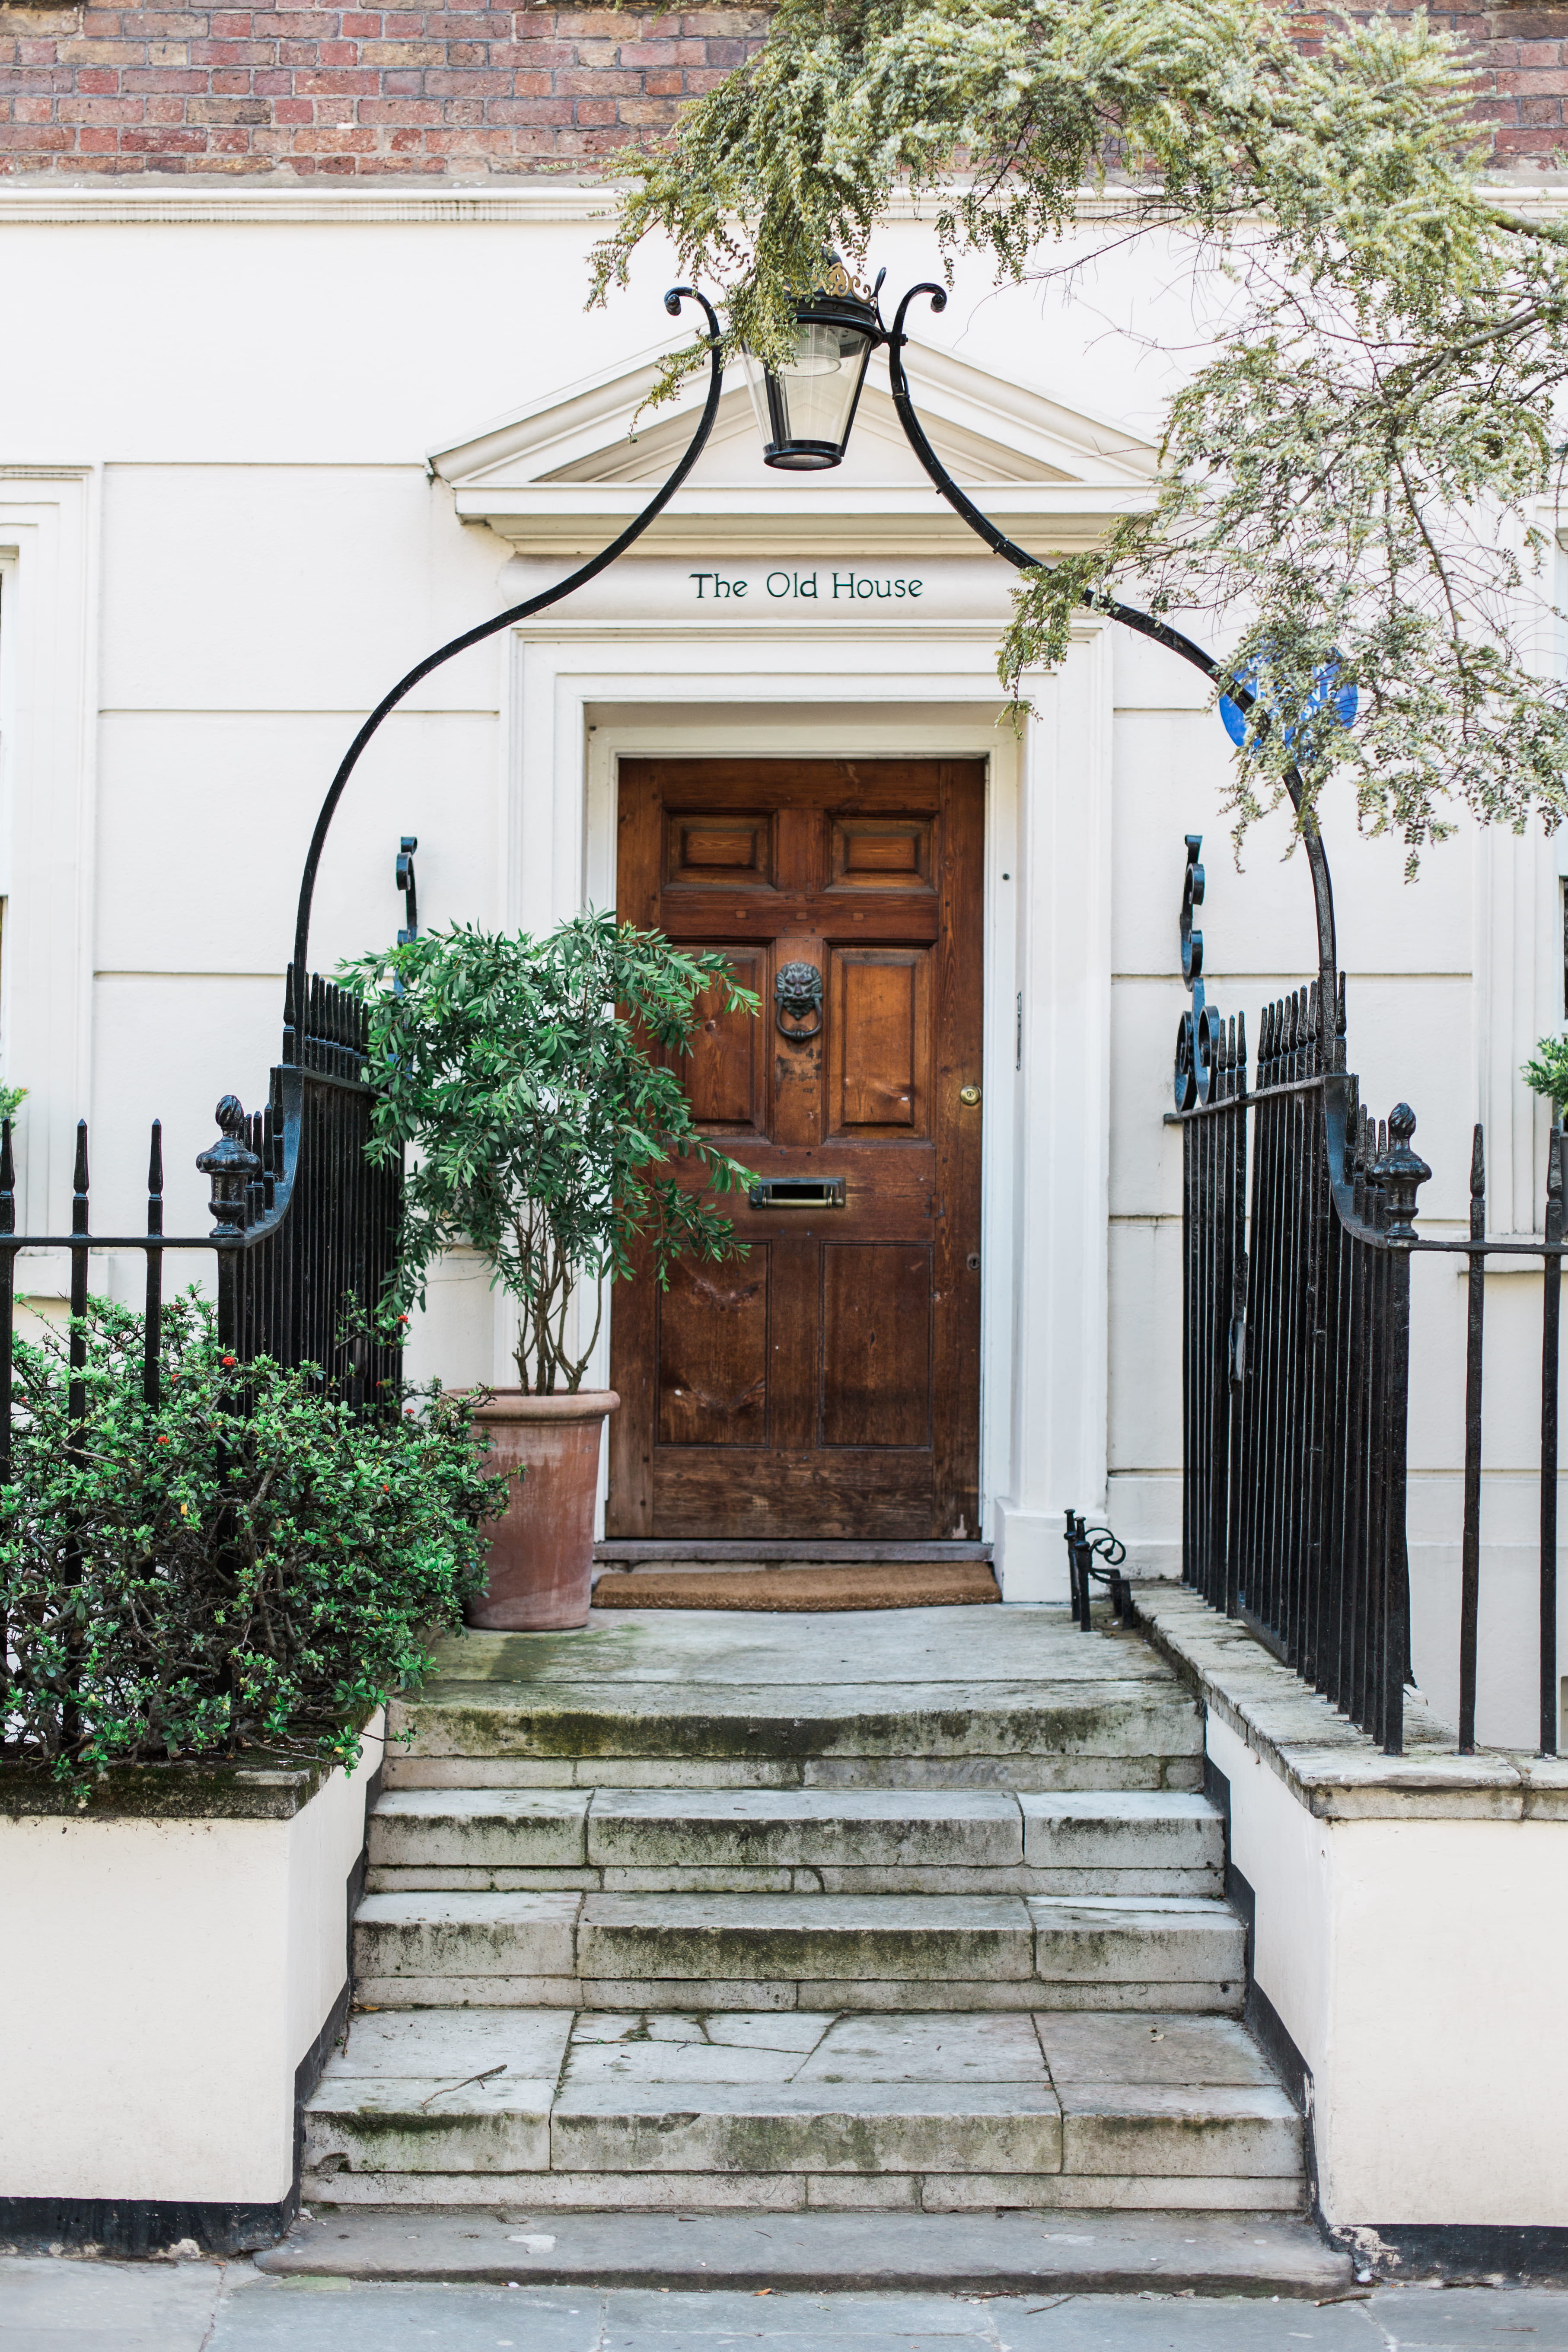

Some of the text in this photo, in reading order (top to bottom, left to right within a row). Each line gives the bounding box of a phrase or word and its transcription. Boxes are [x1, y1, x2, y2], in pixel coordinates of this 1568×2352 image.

[689, 571, 923, 599] The Old House
